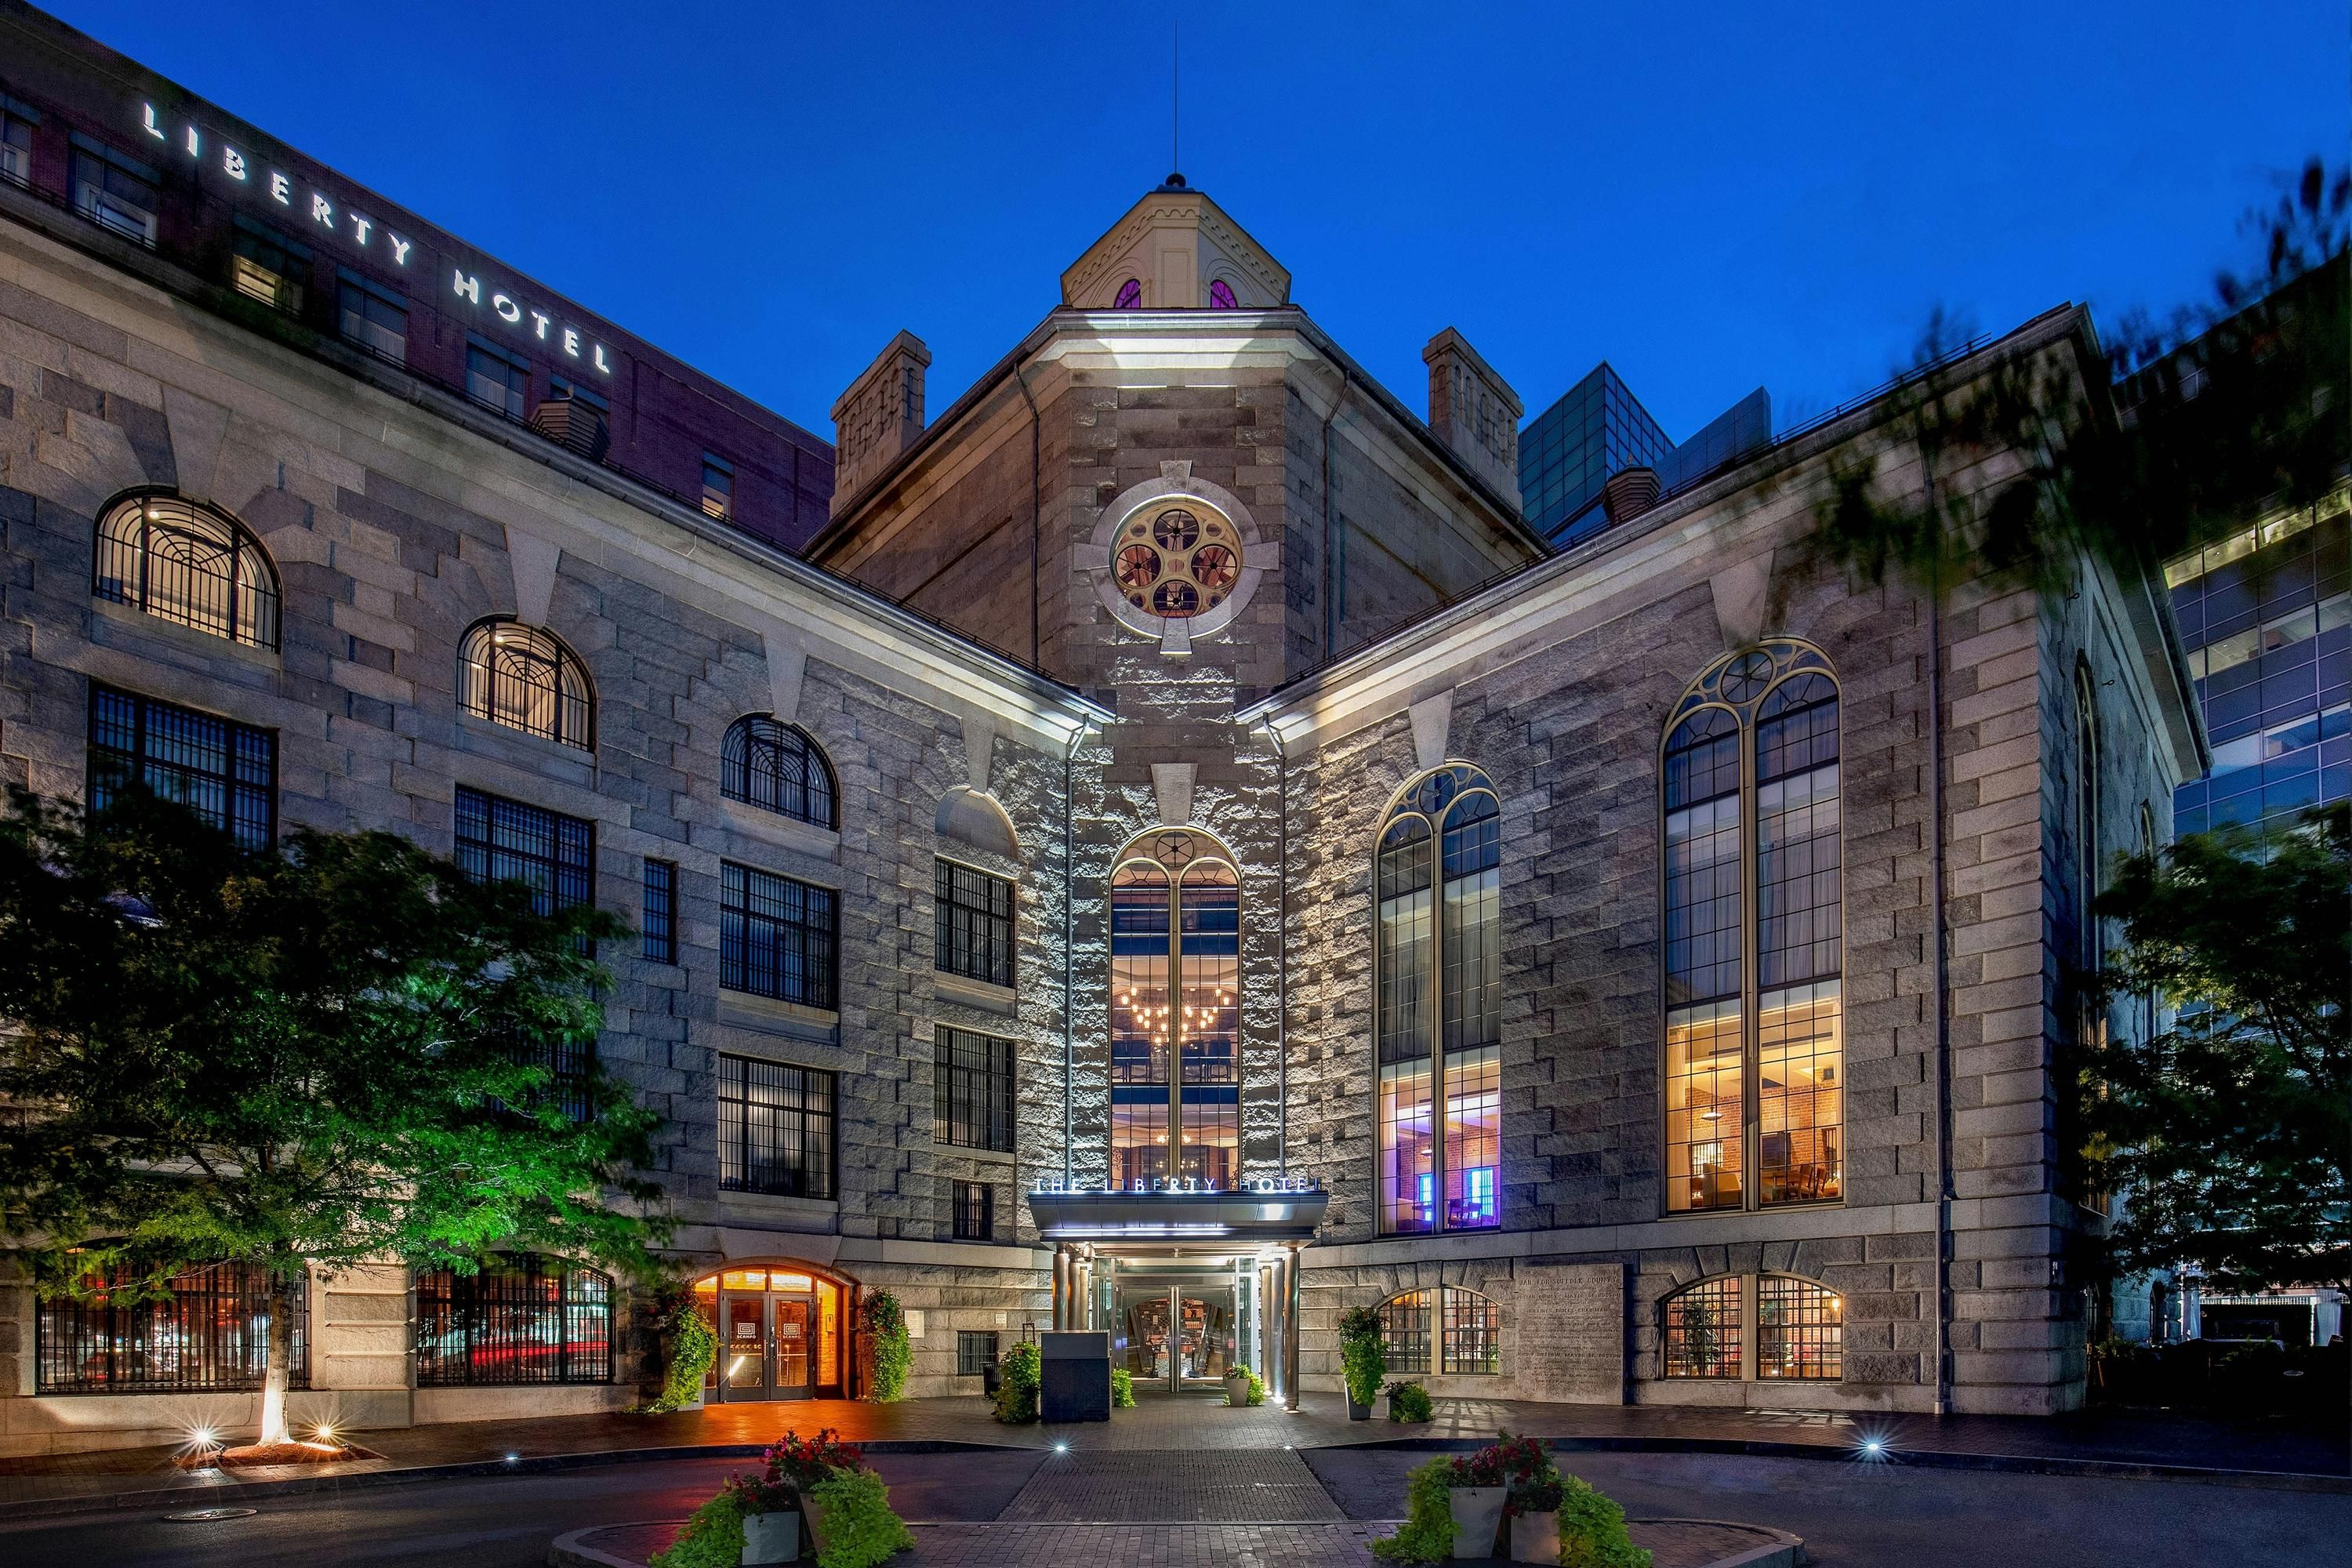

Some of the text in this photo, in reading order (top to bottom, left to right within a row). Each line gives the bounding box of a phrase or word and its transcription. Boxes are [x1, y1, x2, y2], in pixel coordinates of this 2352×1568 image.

[142, 103, 610, 374] LIBERTY HOTEL
[1034, 1178, 1319, 1191] THE LIBERTY HOTEL
